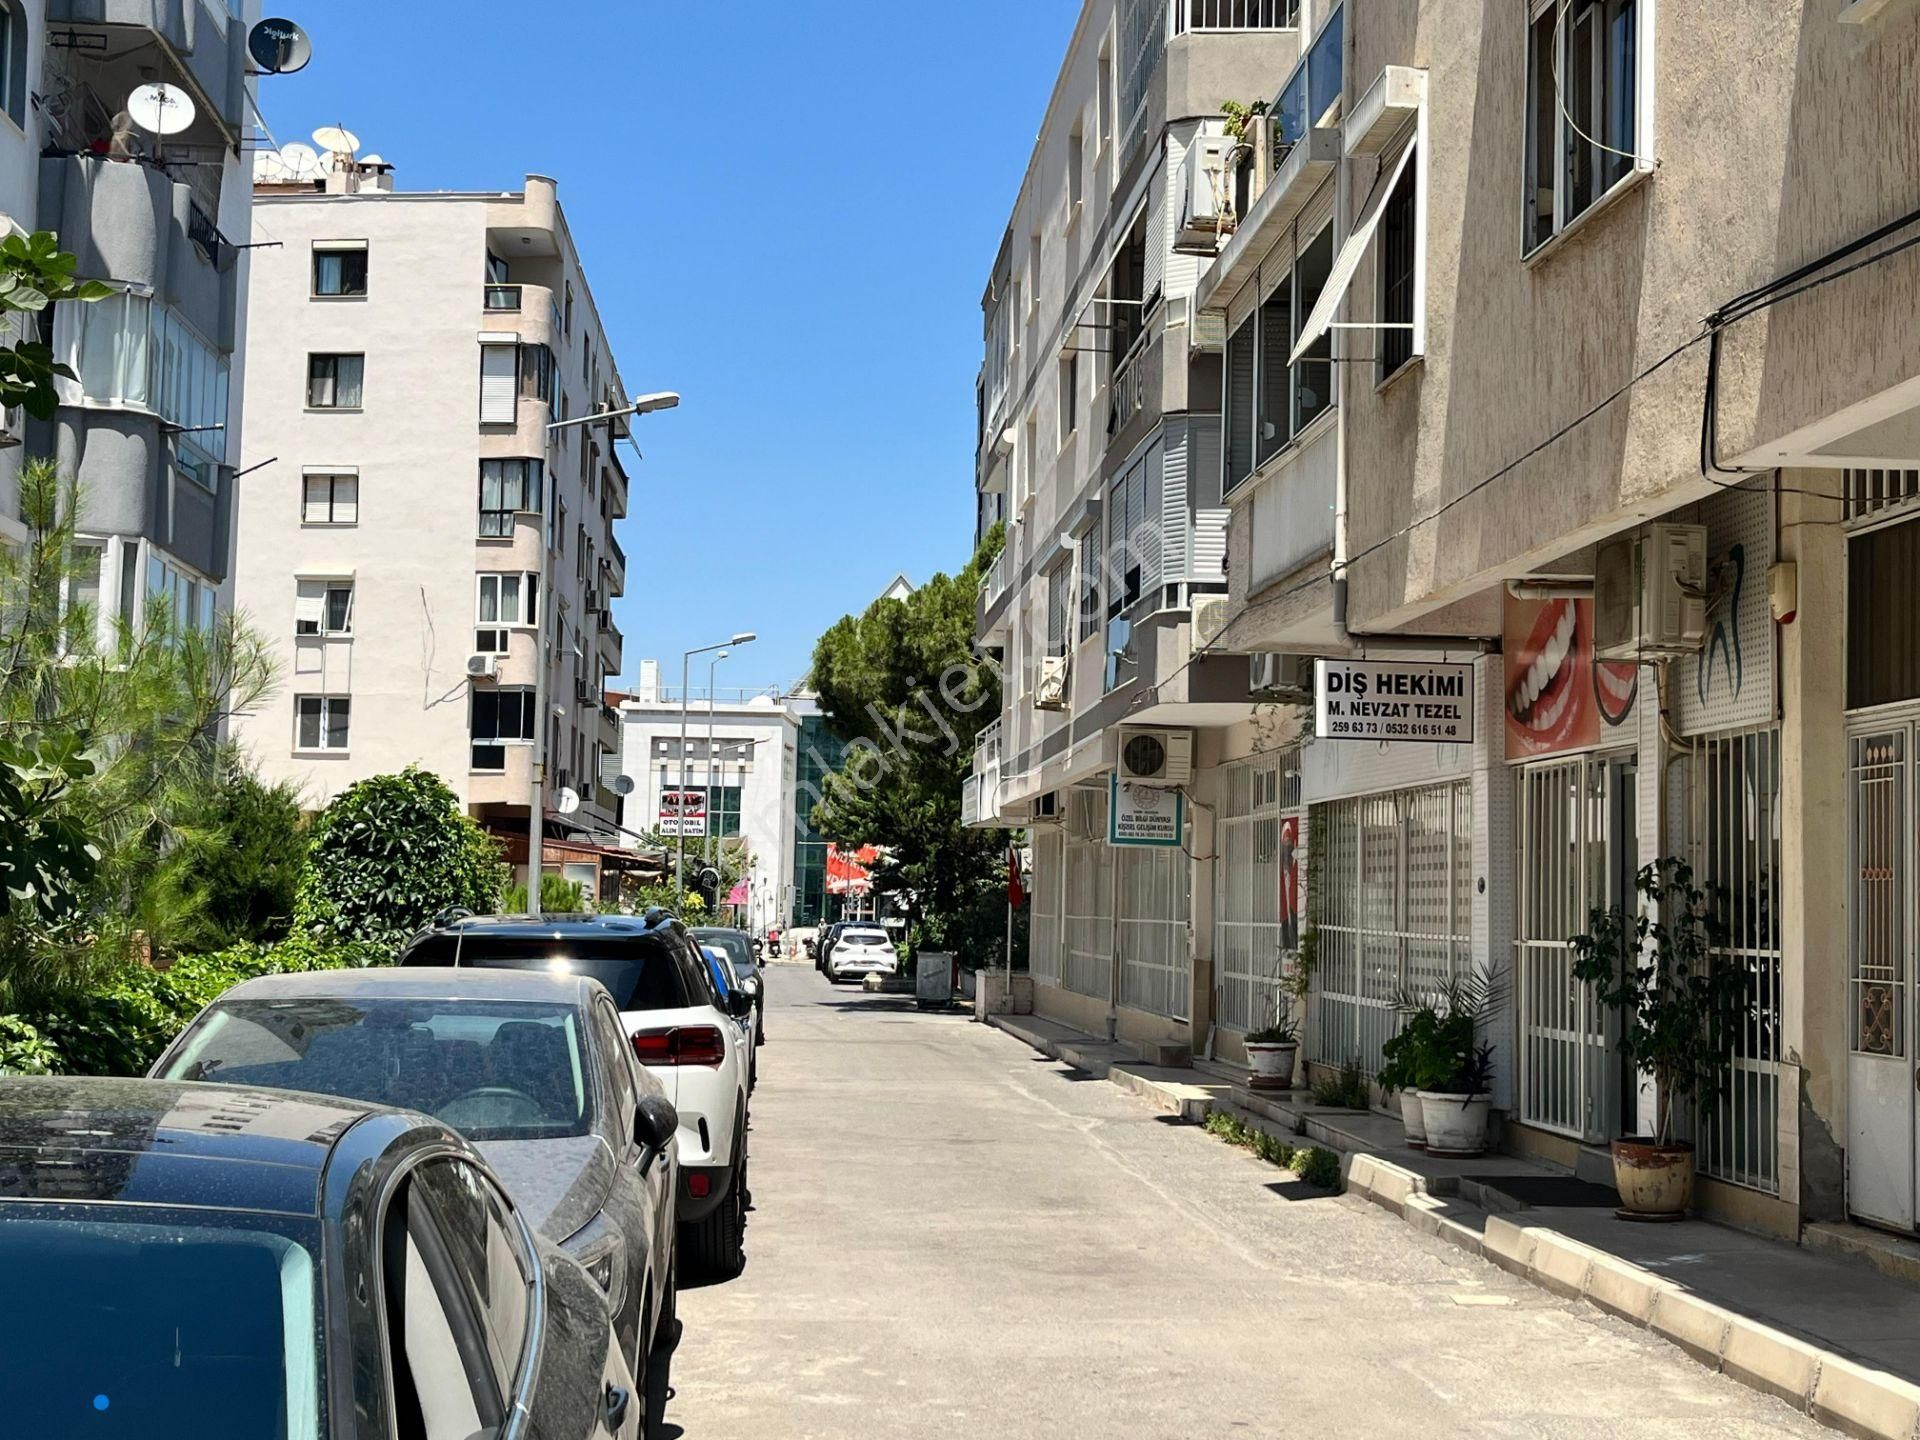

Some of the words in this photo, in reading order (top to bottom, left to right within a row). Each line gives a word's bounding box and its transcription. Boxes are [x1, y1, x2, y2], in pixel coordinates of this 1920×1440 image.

[1328, 667, 1367, 699] DİŞ
[1377, 670, 1464, 696] HEKİMİ
[1328, 701, 1345, 716] M.
[1350, 701, 1409, 717] NEVZAT
[1414, 704, 1461, 719] TEZEL
[1332, 721, 1349, 732] 259
[1352, 722, 1363, 733] 63
[1366, 723, 1377, 733] 73
[1386, 723, 1408, 734] 0532
[1411, 724, 1428, 735] 616
[1431, 725, 1441, 735] 51
[1445, 725, 1456, 736] 48
